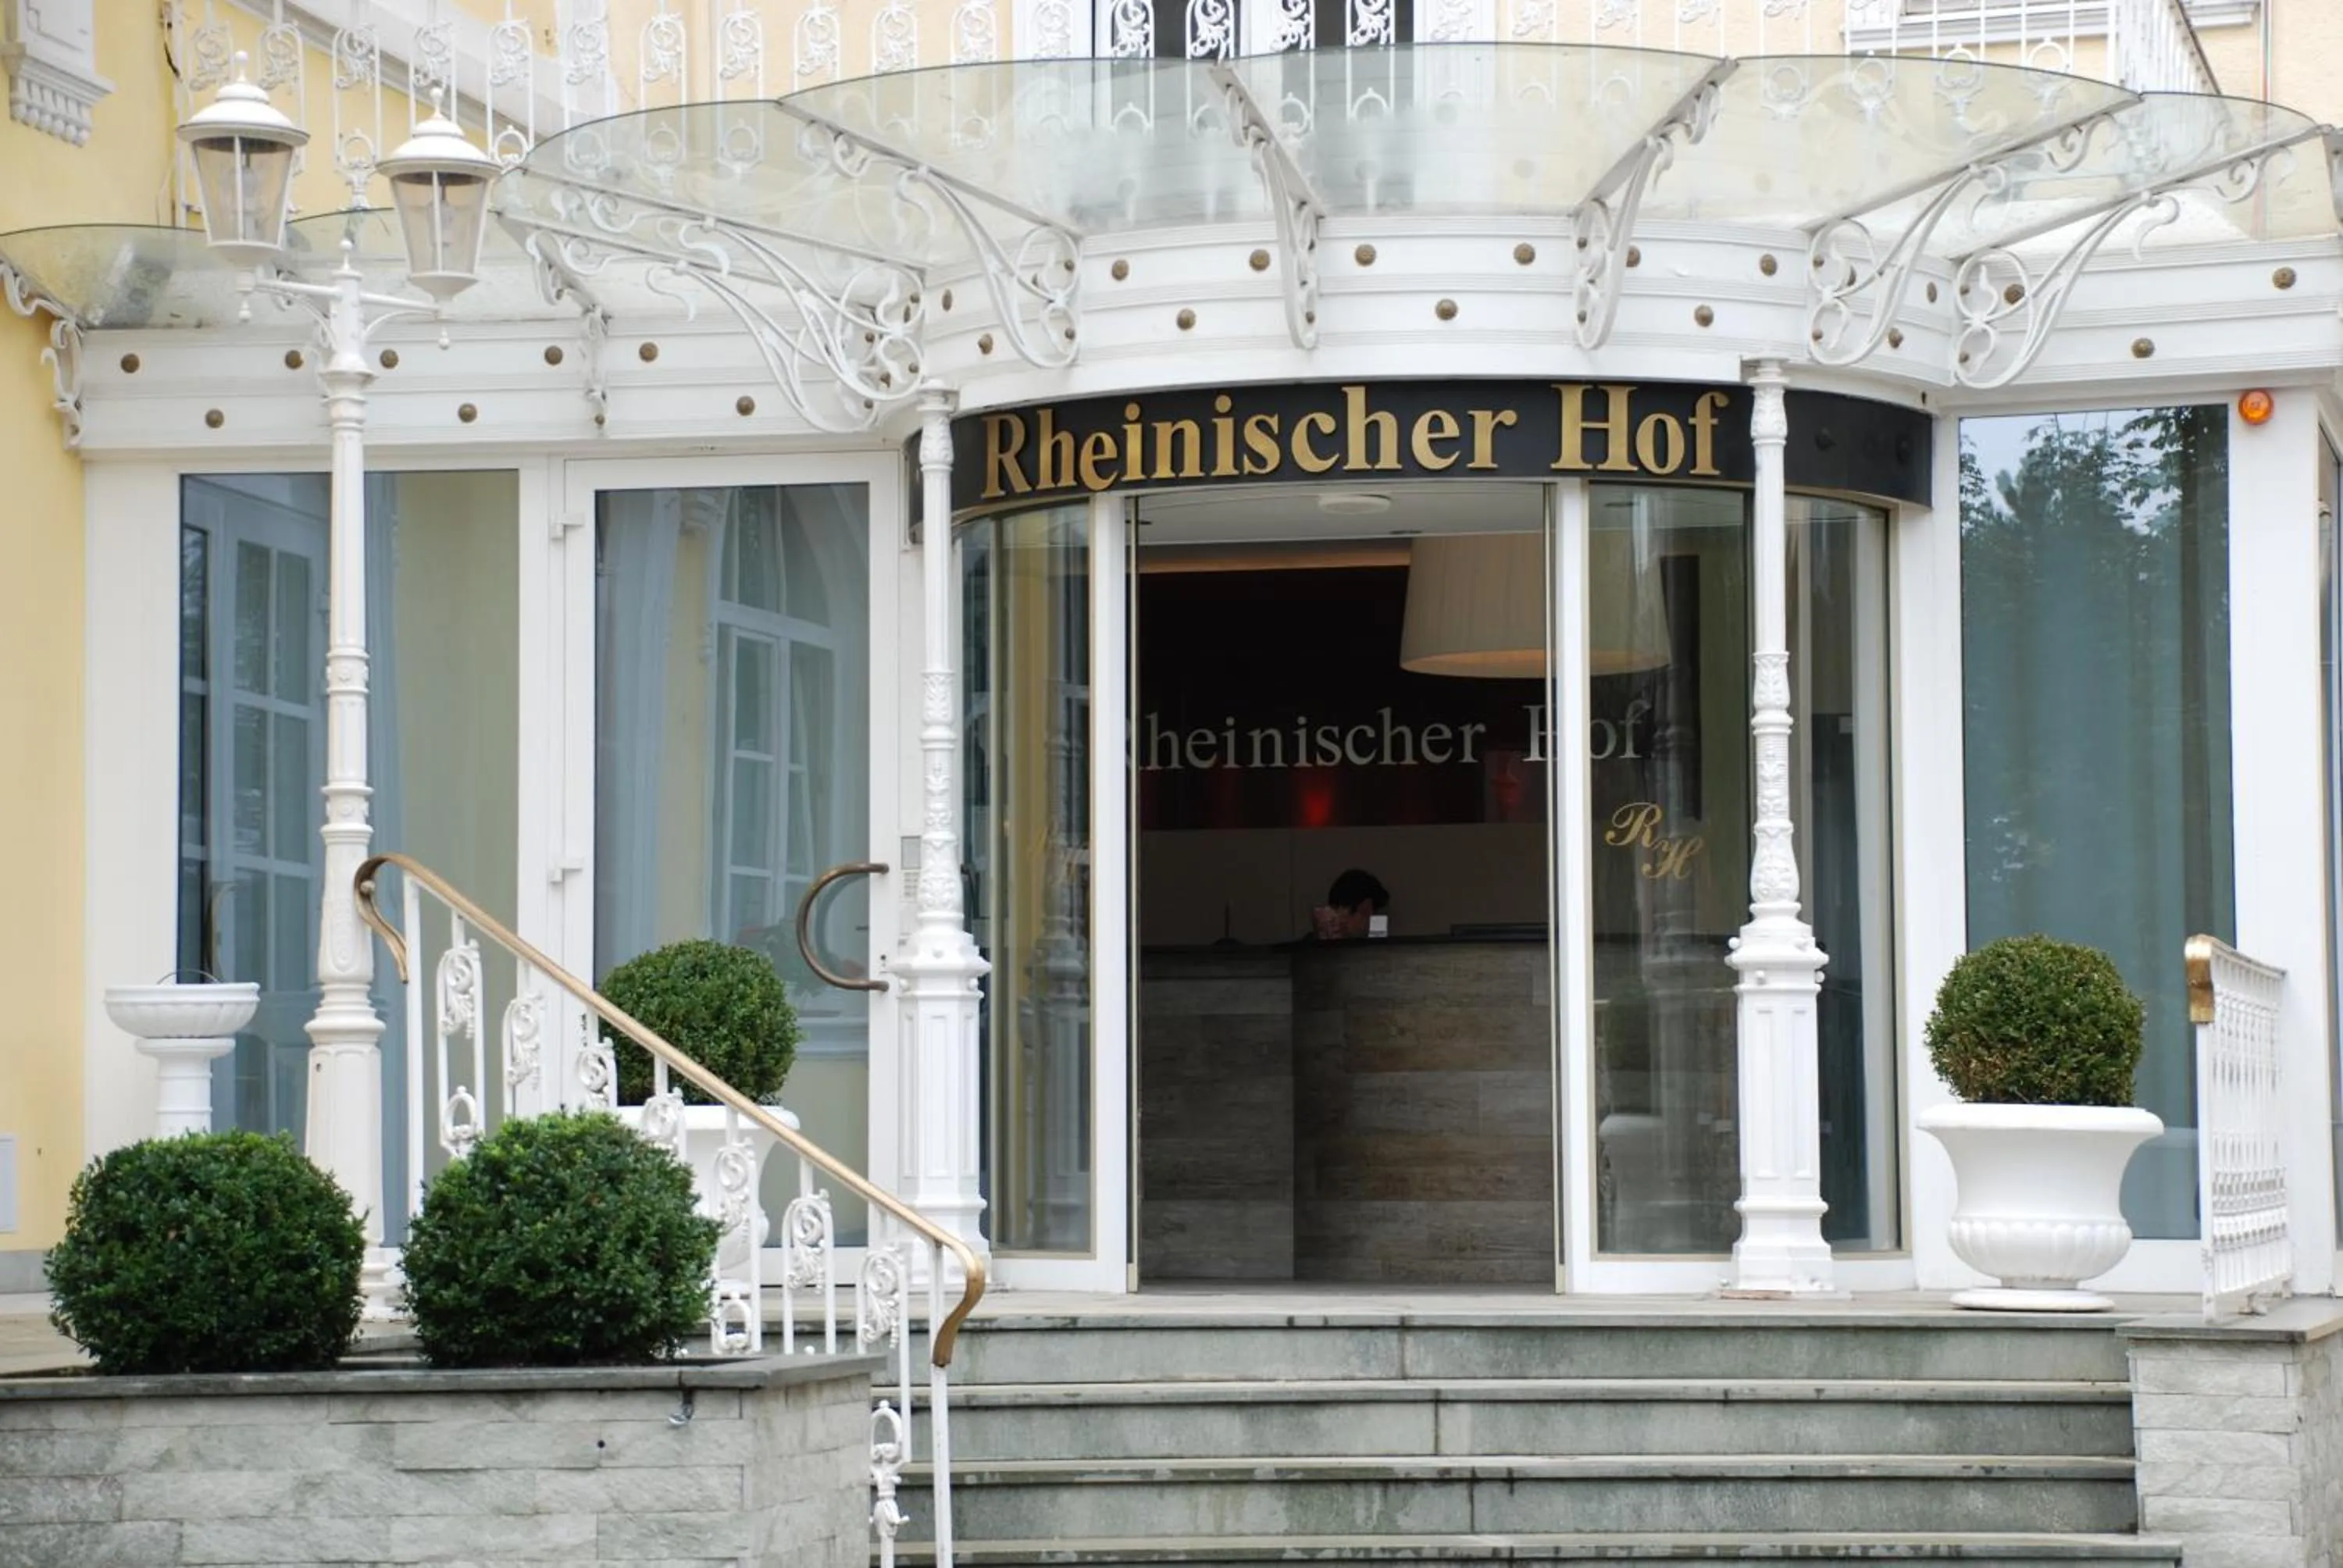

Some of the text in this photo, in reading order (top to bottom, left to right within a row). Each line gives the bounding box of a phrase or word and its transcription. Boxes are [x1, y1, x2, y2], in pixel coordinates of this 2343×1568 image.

[981, 384, 1729, 499] Rheinischer Hof
[1127, 707, 1487, 770] heinischer
